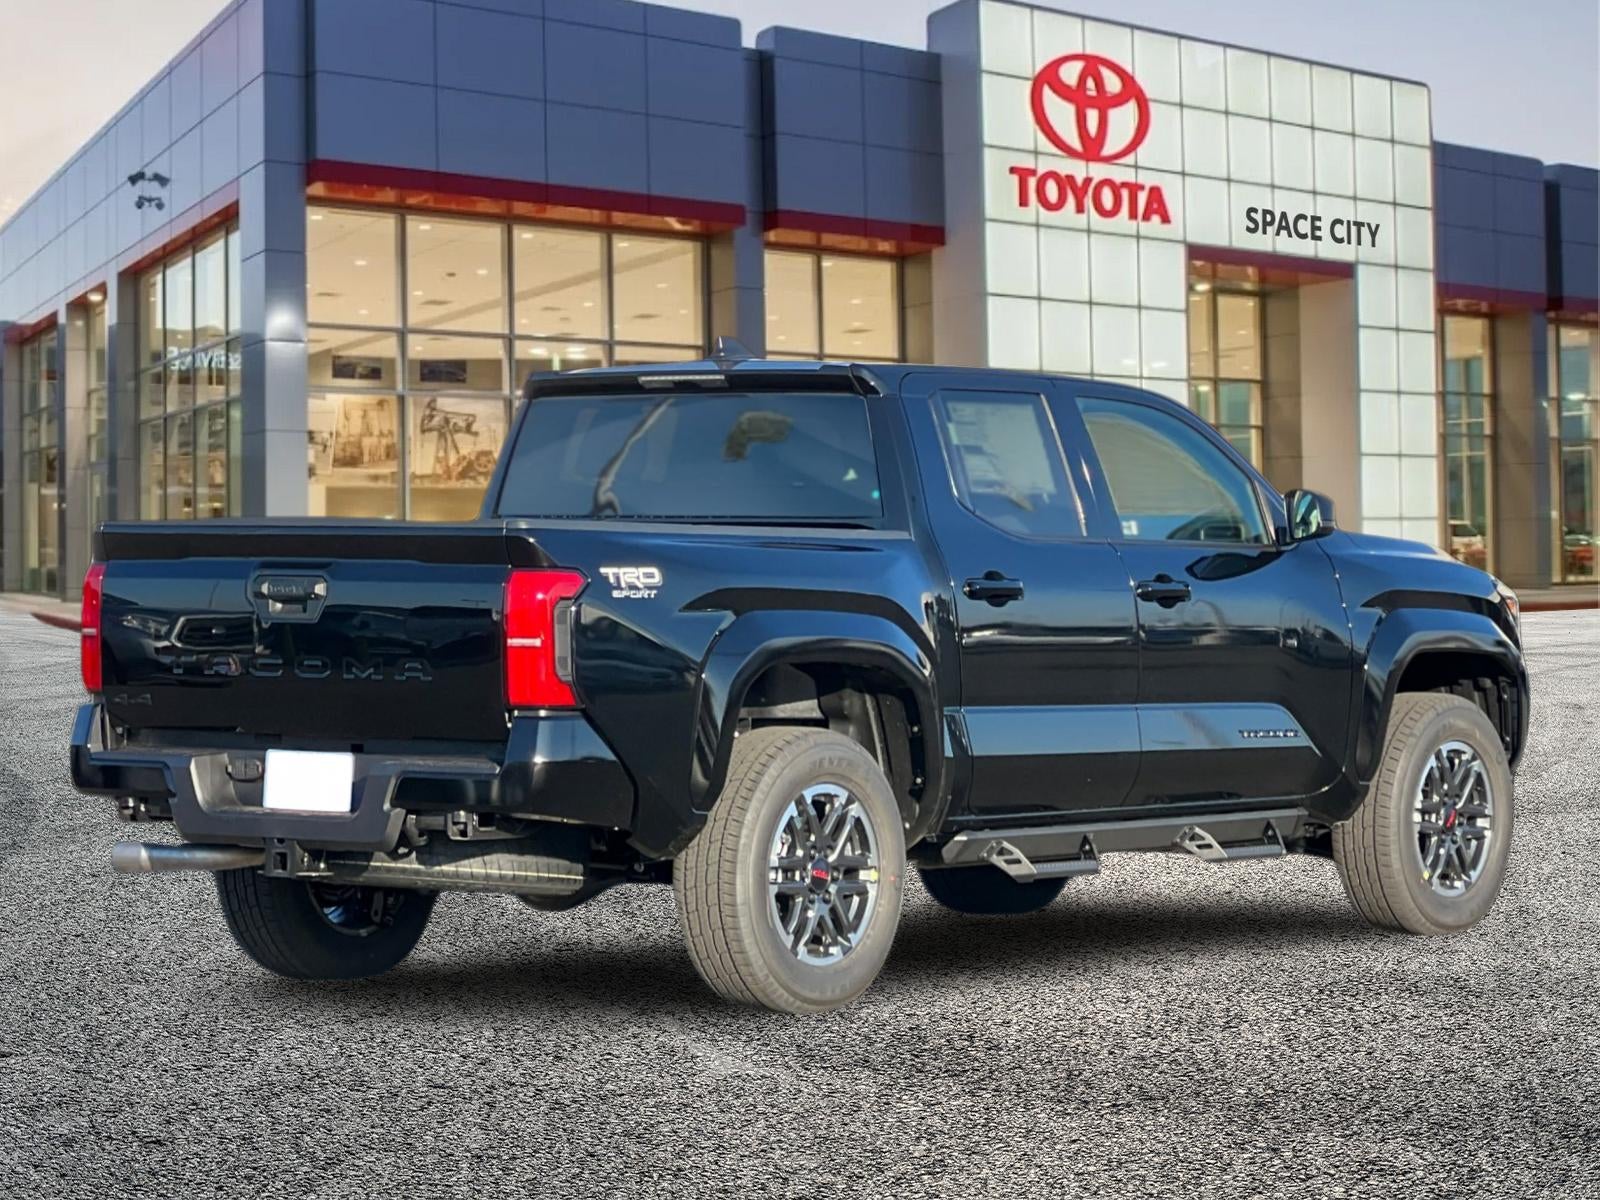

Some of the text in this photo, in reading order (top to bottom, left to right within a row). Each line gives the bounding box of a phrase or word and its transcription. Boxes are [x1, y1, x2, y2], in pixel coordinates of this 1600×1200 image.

[1009, 166, 1171, 225] TOYOTA
[1245, 206, 1381, 248] SPACE CITY
[599, 566, 663, 588] TRD
[163, 654, 433, 682] TACOMA
